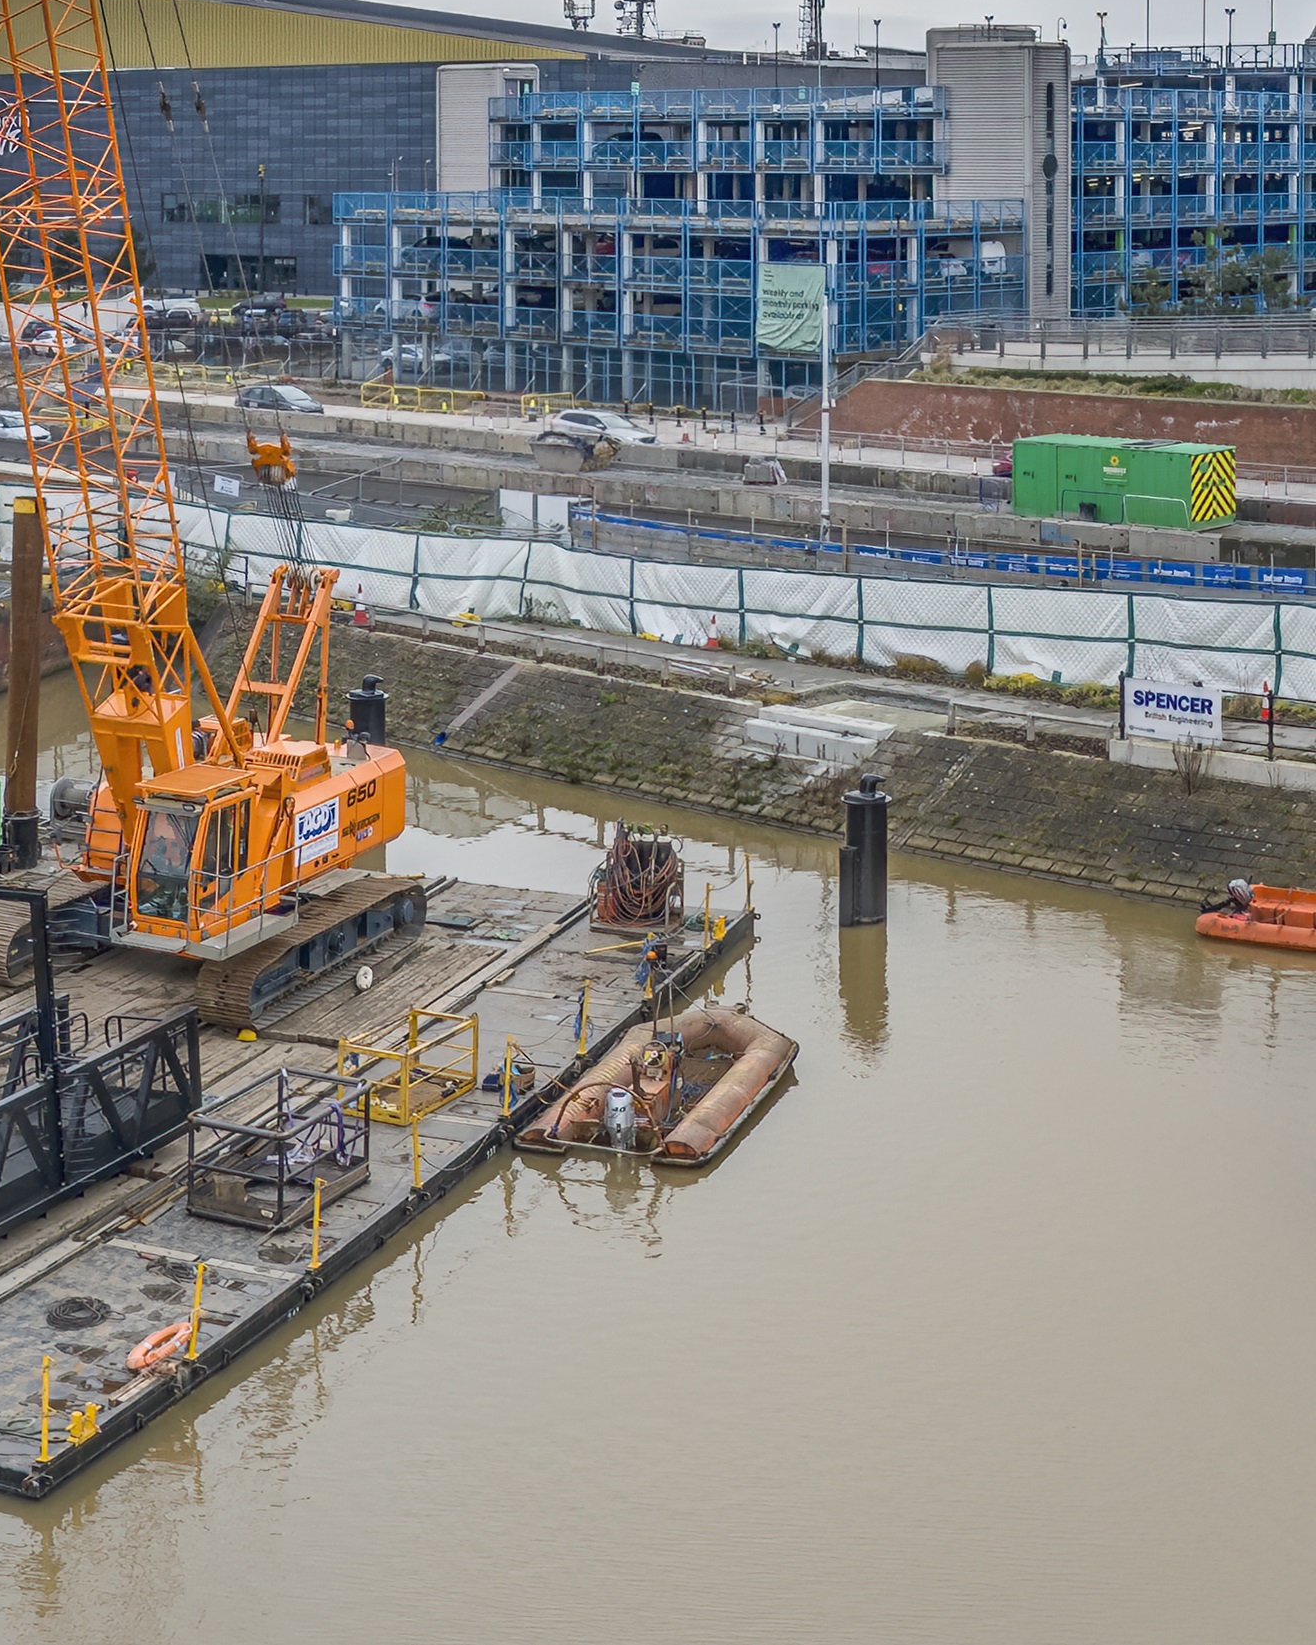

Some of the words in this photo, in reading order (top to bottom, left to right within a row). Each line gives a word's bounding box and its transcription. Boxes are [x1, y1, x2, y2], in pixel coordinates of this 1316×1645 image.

[1133, 689, 1214, 715] SPENCER
[1168, 713, 1214, 729] Engineering
[347, 778, 377, 808] 650
